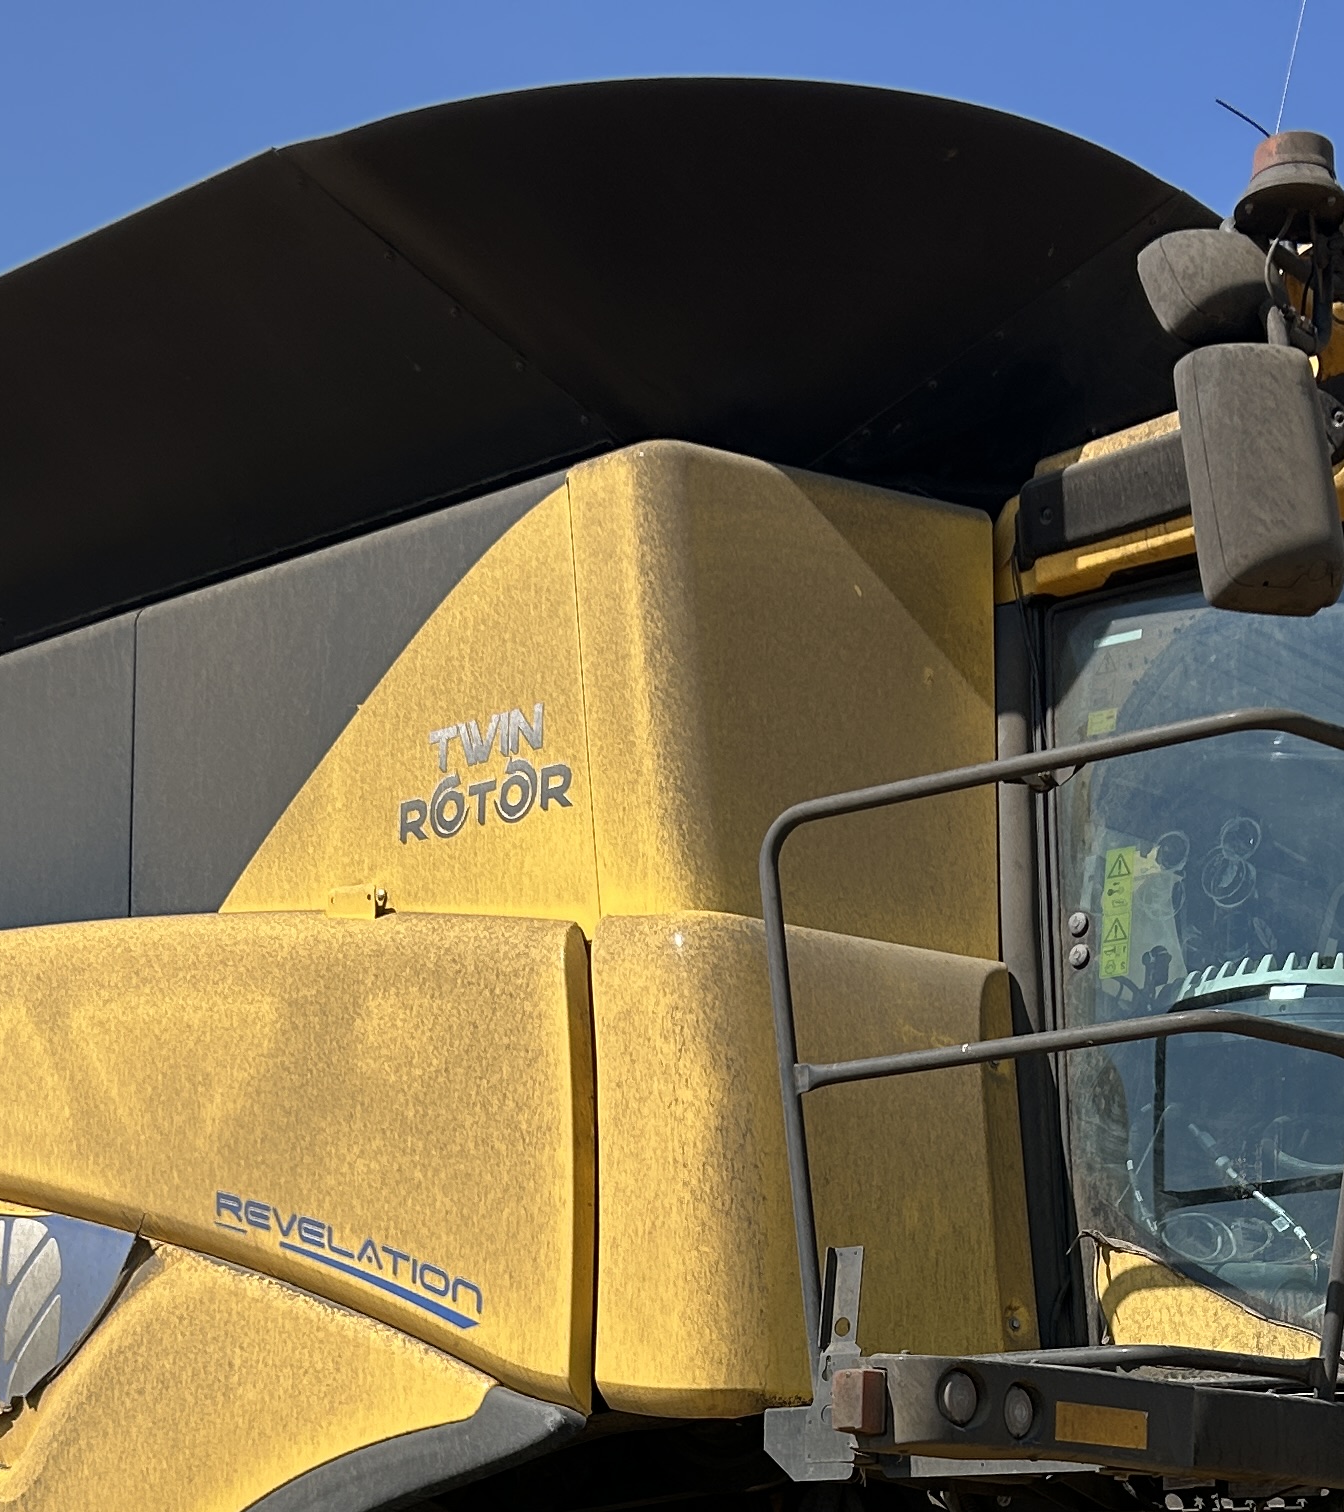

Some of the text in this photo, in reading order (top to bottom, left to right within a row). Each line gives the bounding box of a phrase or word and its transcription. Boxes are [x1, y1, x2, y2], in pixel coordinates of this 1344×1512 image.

[429, 702, 545, 773] TWIN
[399, 756, 573, 845] ROTOR
[215, 1190, 484, 1315] REVELATION
